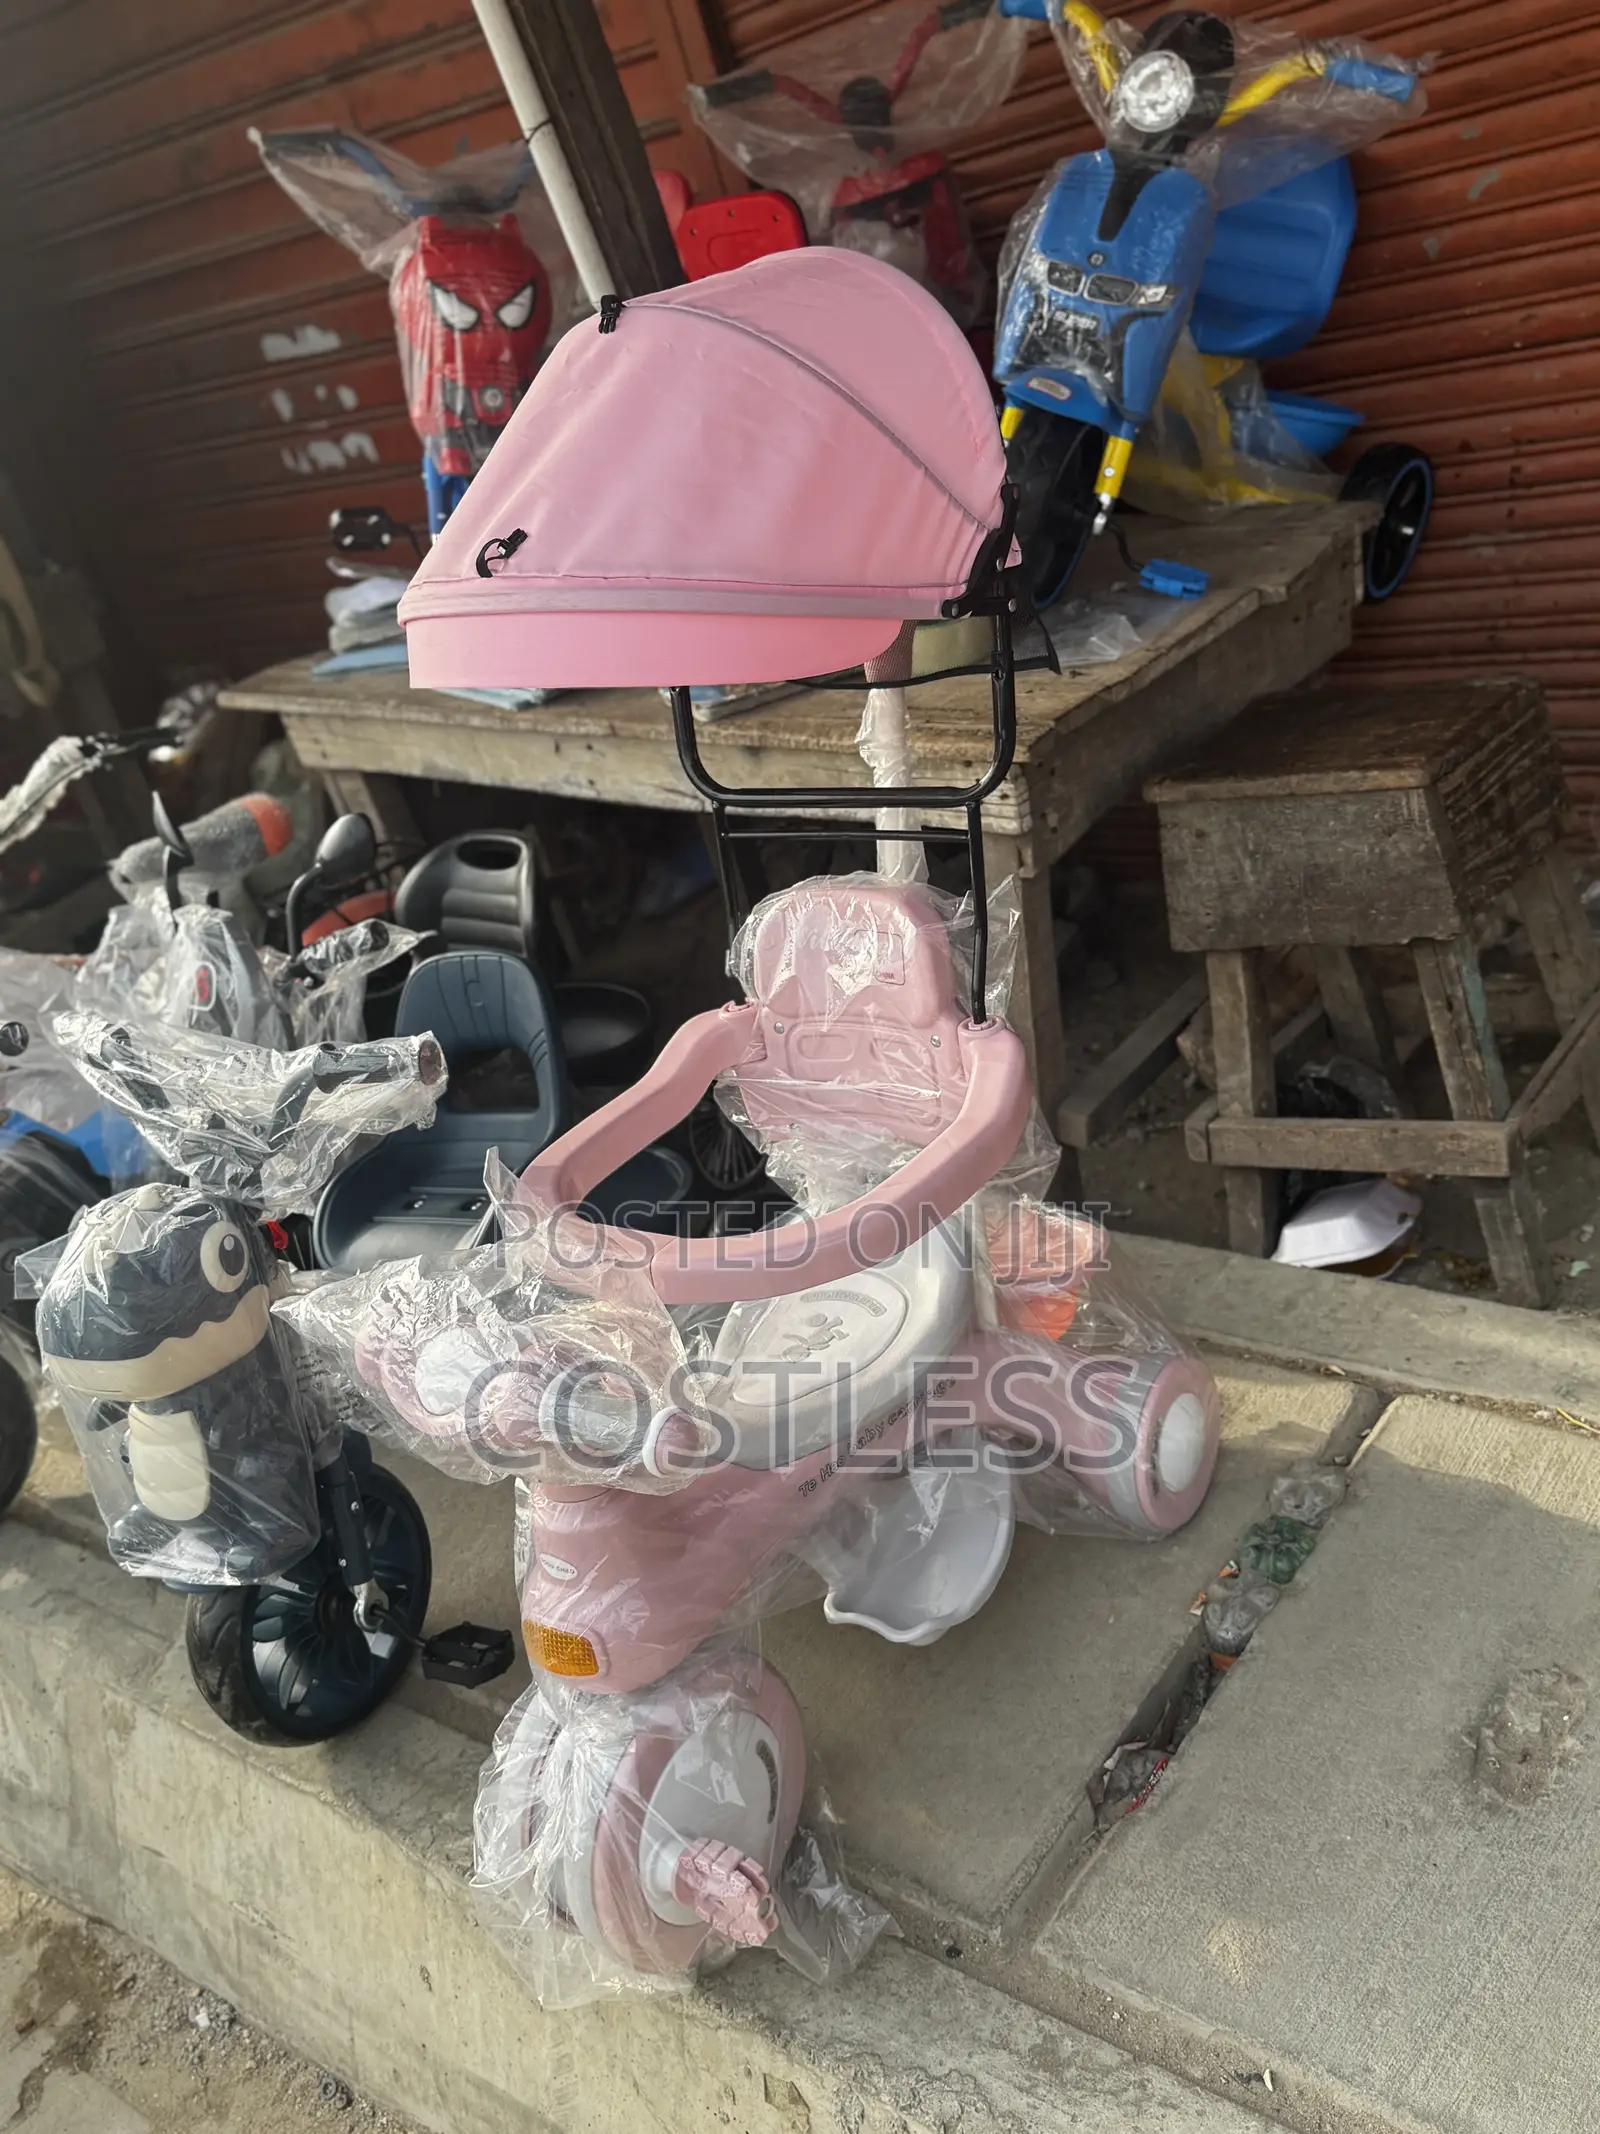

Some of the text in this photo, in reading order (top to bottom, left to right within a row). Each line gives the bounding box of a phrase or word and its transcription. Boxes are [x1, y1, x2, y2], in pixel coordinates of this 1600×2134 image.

[798, 1478, 817, 1498] Te
[819, 1454, 846, 1483] Hao
[846, 1420, 886, 1457] baby
